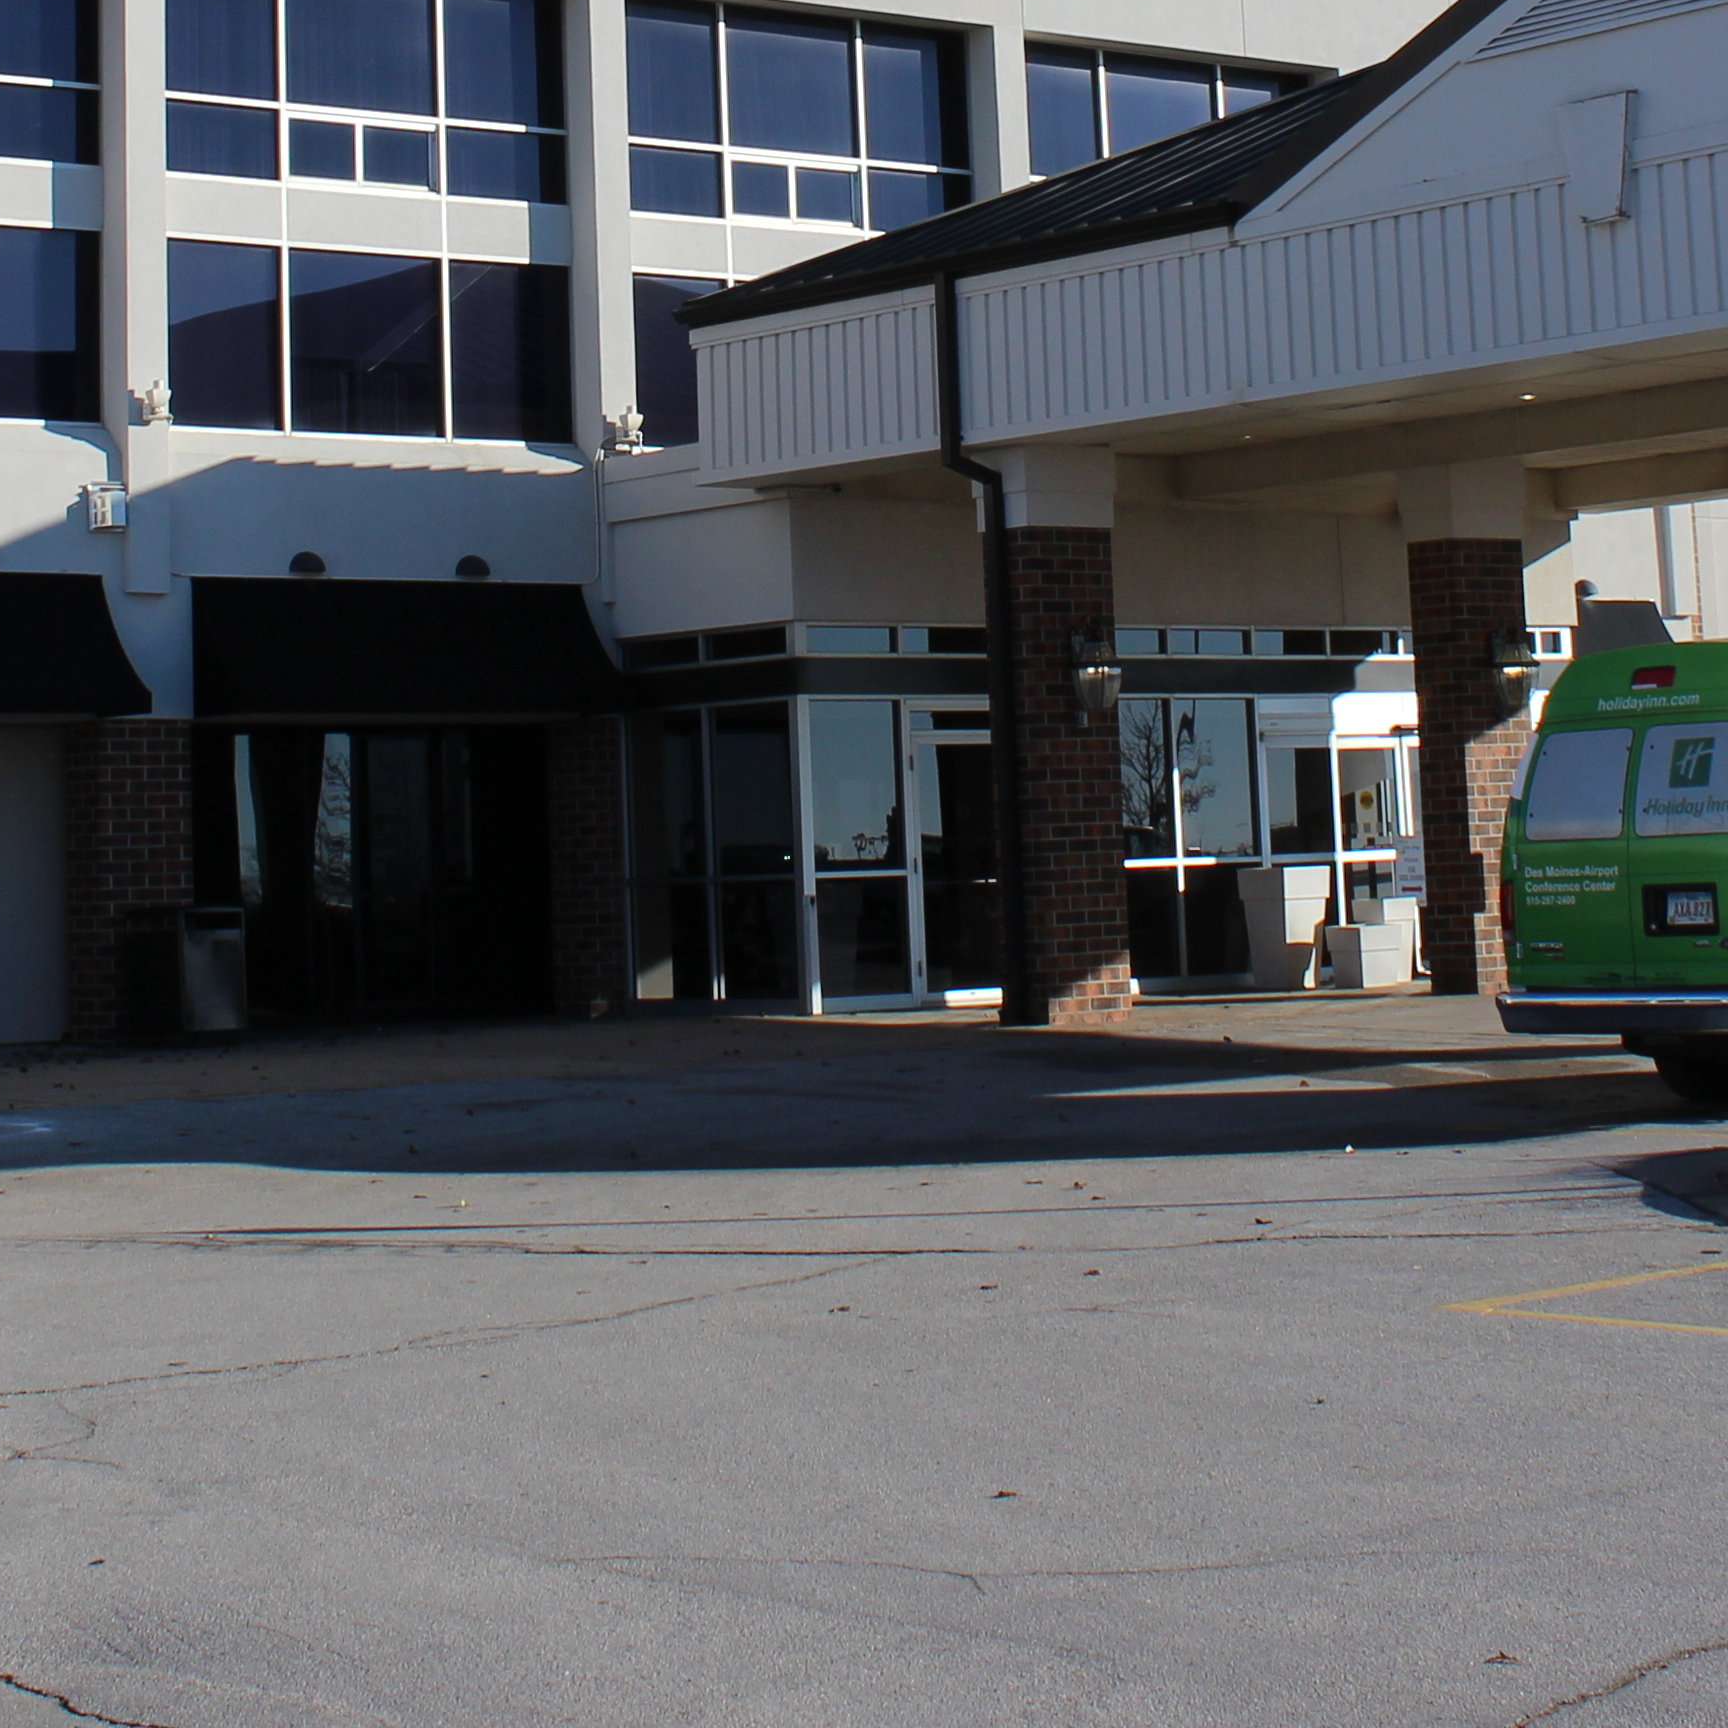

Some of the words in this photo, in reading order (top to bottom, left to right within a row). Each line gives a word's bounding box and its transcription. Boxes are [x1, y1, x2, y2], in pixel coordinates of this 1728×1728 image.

[1597, 693, 1701, 711] holidayinn.com
[1645, 796, 1704, 817] Holiday
[1524, 866, 1544, 878] Des
[1524, 881, 1581, 893] Conference
[1583, 880, 1616, 891] Center
